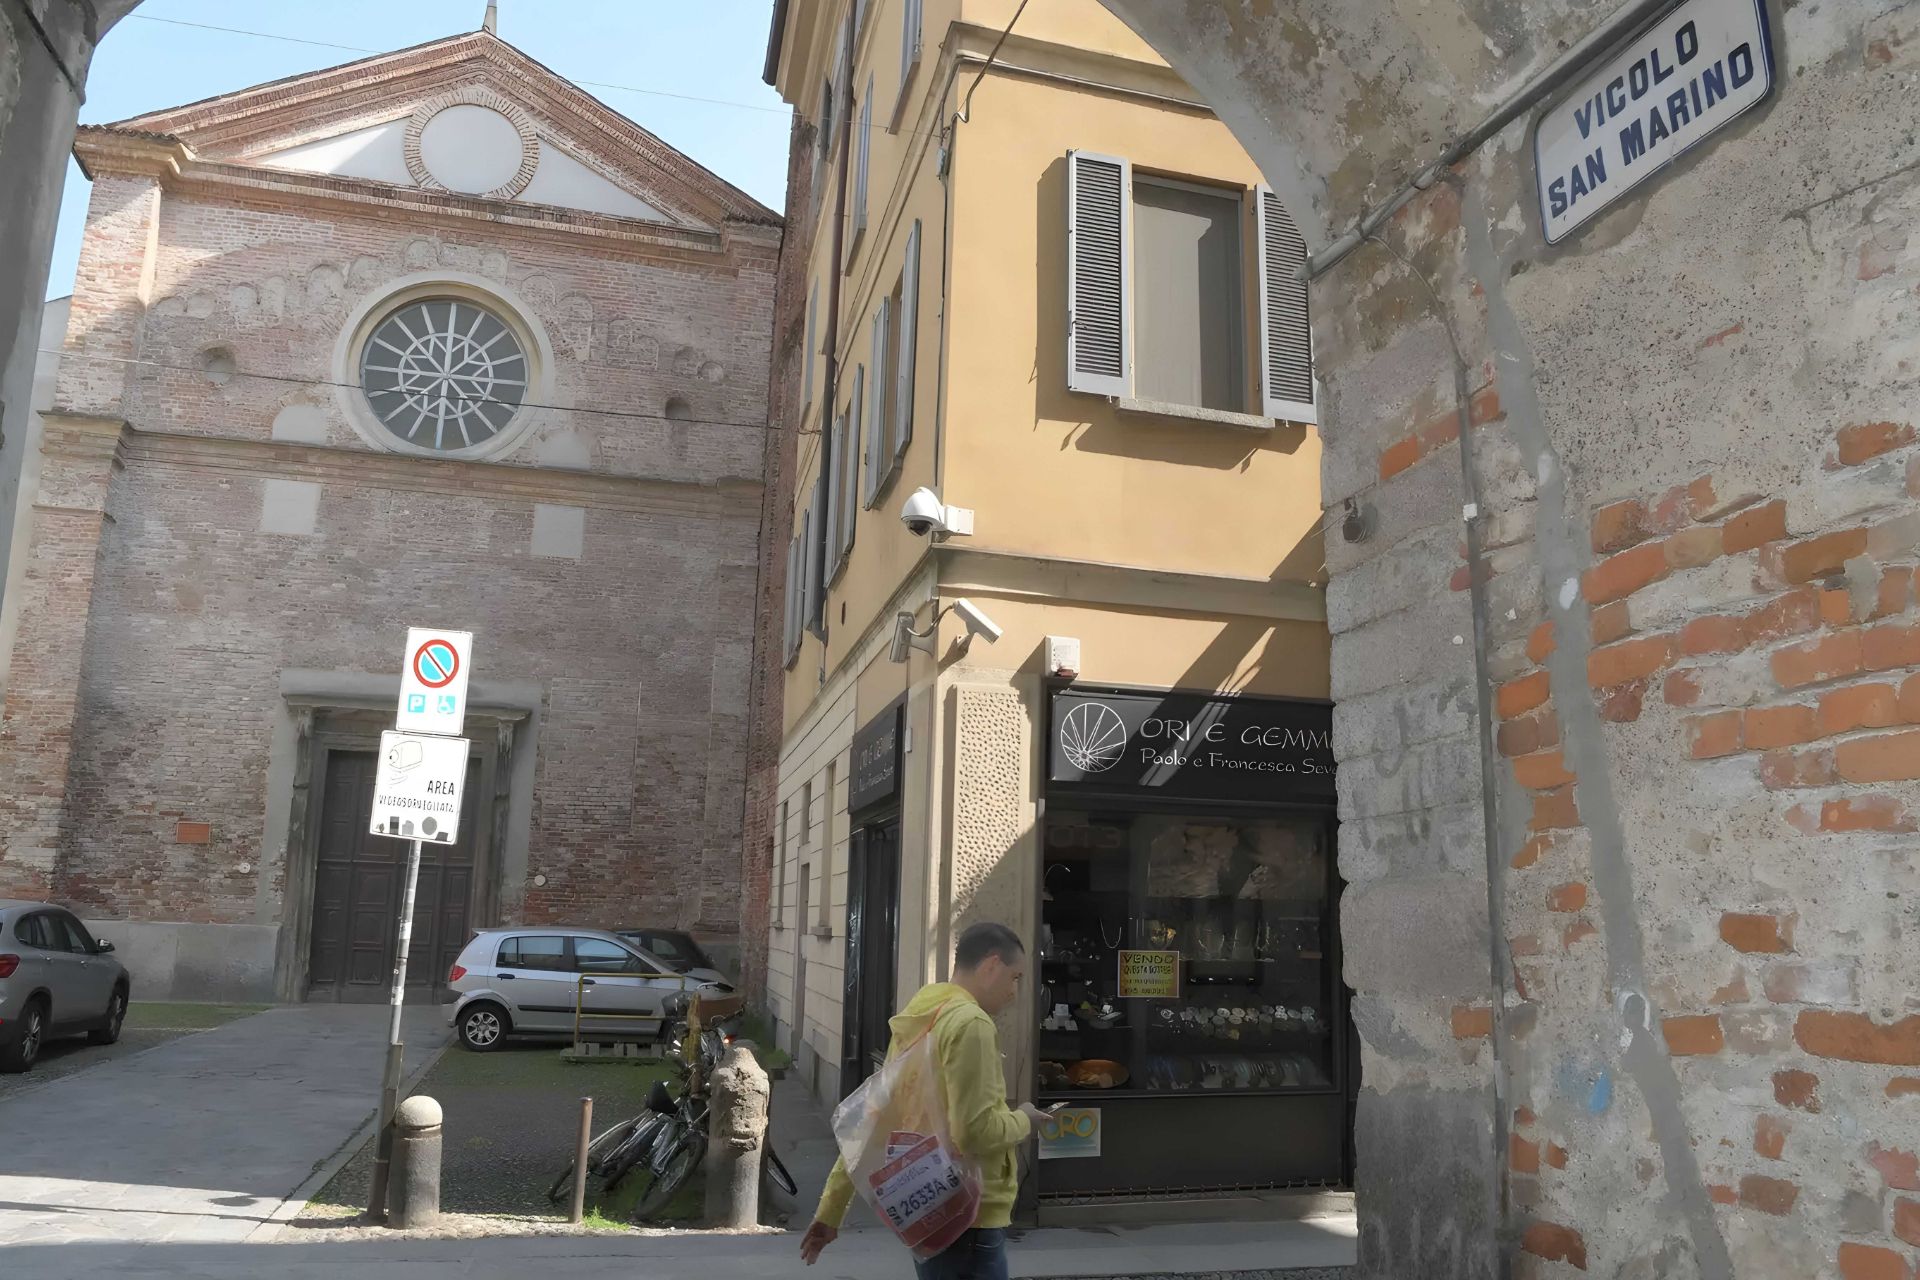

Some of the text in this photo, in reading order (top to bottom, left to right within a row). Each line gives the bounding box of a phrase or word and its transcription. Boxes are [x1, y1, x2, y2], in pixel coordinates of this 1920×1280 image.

[1573, 20, 1699, 140] VICOLO
[1548, 41, 1754, 220] SAN MARINO
[1139, 717, 1190, 742] ORI
[1205, 723, 1226, 742] E
[1140, 748, 1187, 766] Paolo
[1193, 758, 1203, 767] e
[1208, 752, 1296, 773] Francesca
[427, 780, 455, 796] AREA
[1123, 954, 1175, 964] VENDO
